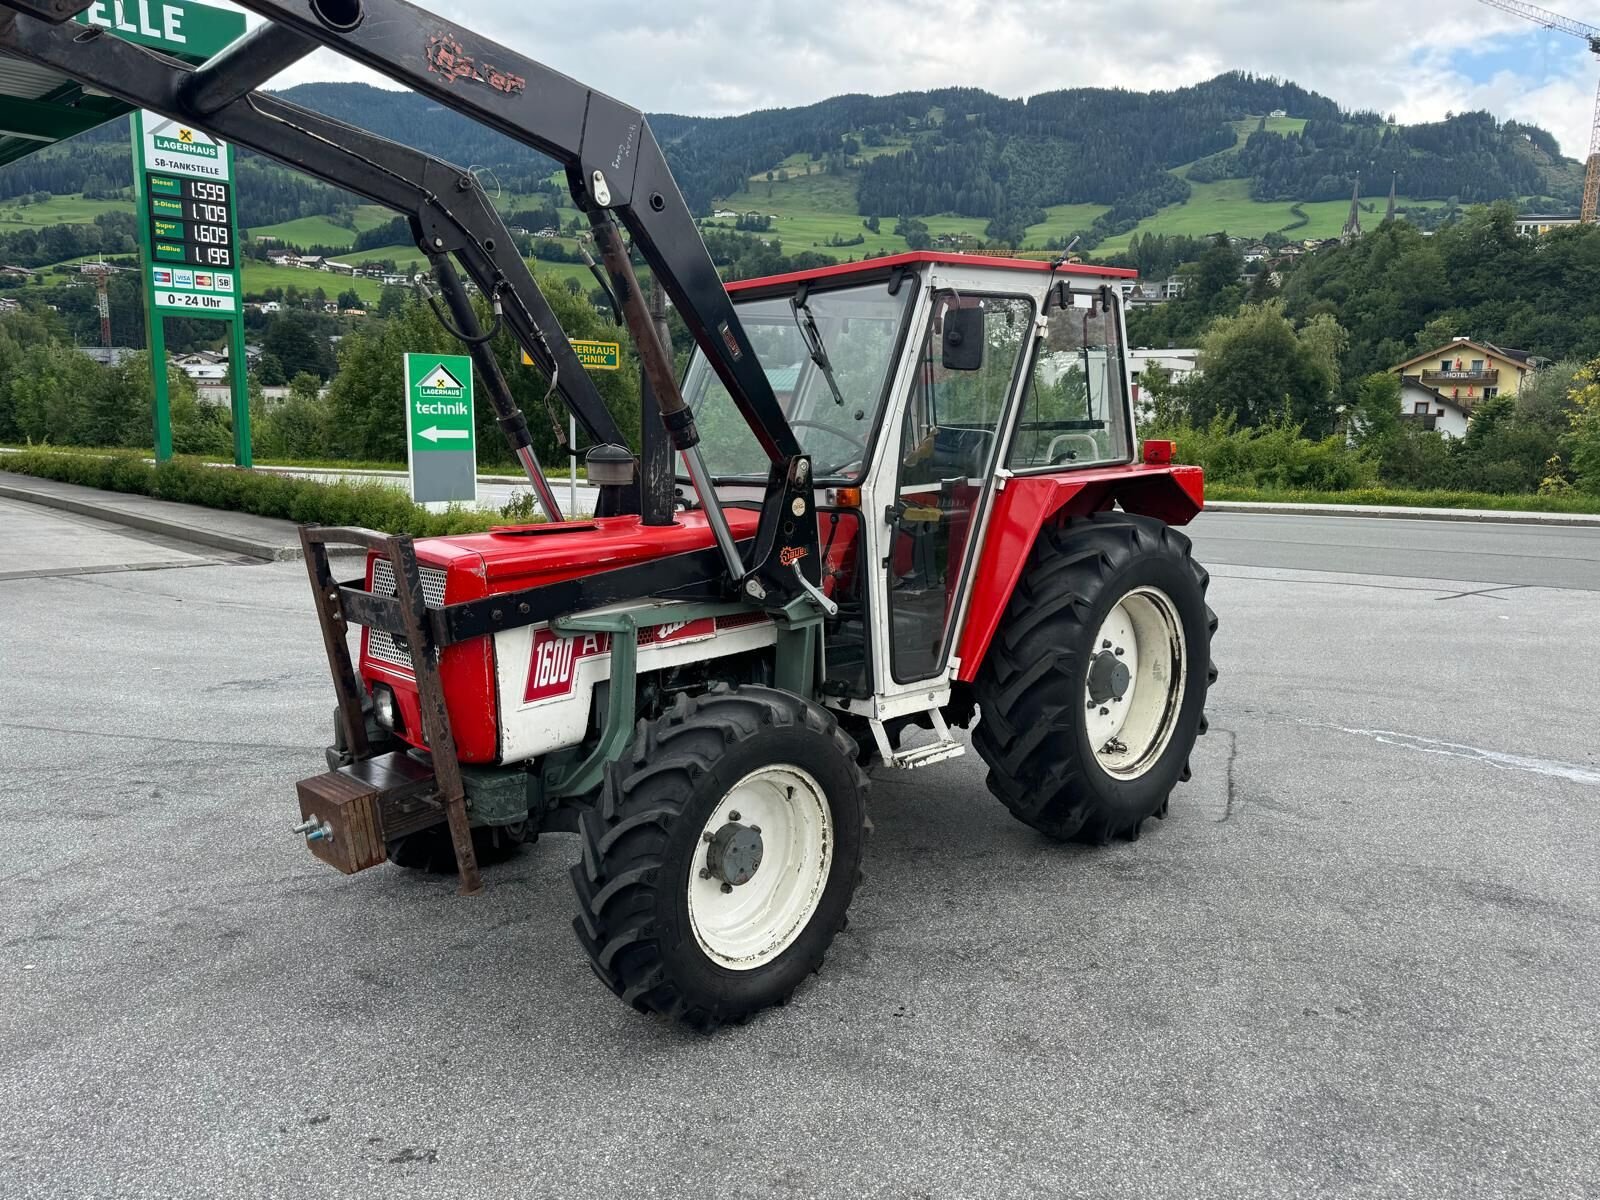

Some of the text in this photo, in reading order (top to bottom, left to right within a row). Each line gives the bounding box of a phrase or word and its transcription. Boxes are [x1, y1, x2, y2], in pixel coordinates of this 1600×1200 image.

[72, 0, 187, 44] ELLE
[156, 139, 216, 156] LAGERHAUS
[154, 158, 220, 175] SB-TANKSTELLE
[152, 178, 174, 187] Diesel
[191, 182, 226, 202] 1.599
[153, 200, 182, 209] S-Diesel
[192, 203, 227, 223] 1.709
[155, 221, 176, 230] Super
[194, 225, 229, 245] 1.609
[156, 244, 181, 253] AdBlue
[218, 278, 229, 287] SB
[185, 295, 199, 306] 24
[202, 296, 221, 308] Uhr
[422, 388, 460, 396] LAGERHAUS
[415, 400, 468, 415] technik
[533, 632, 599, 689] 1600 A
